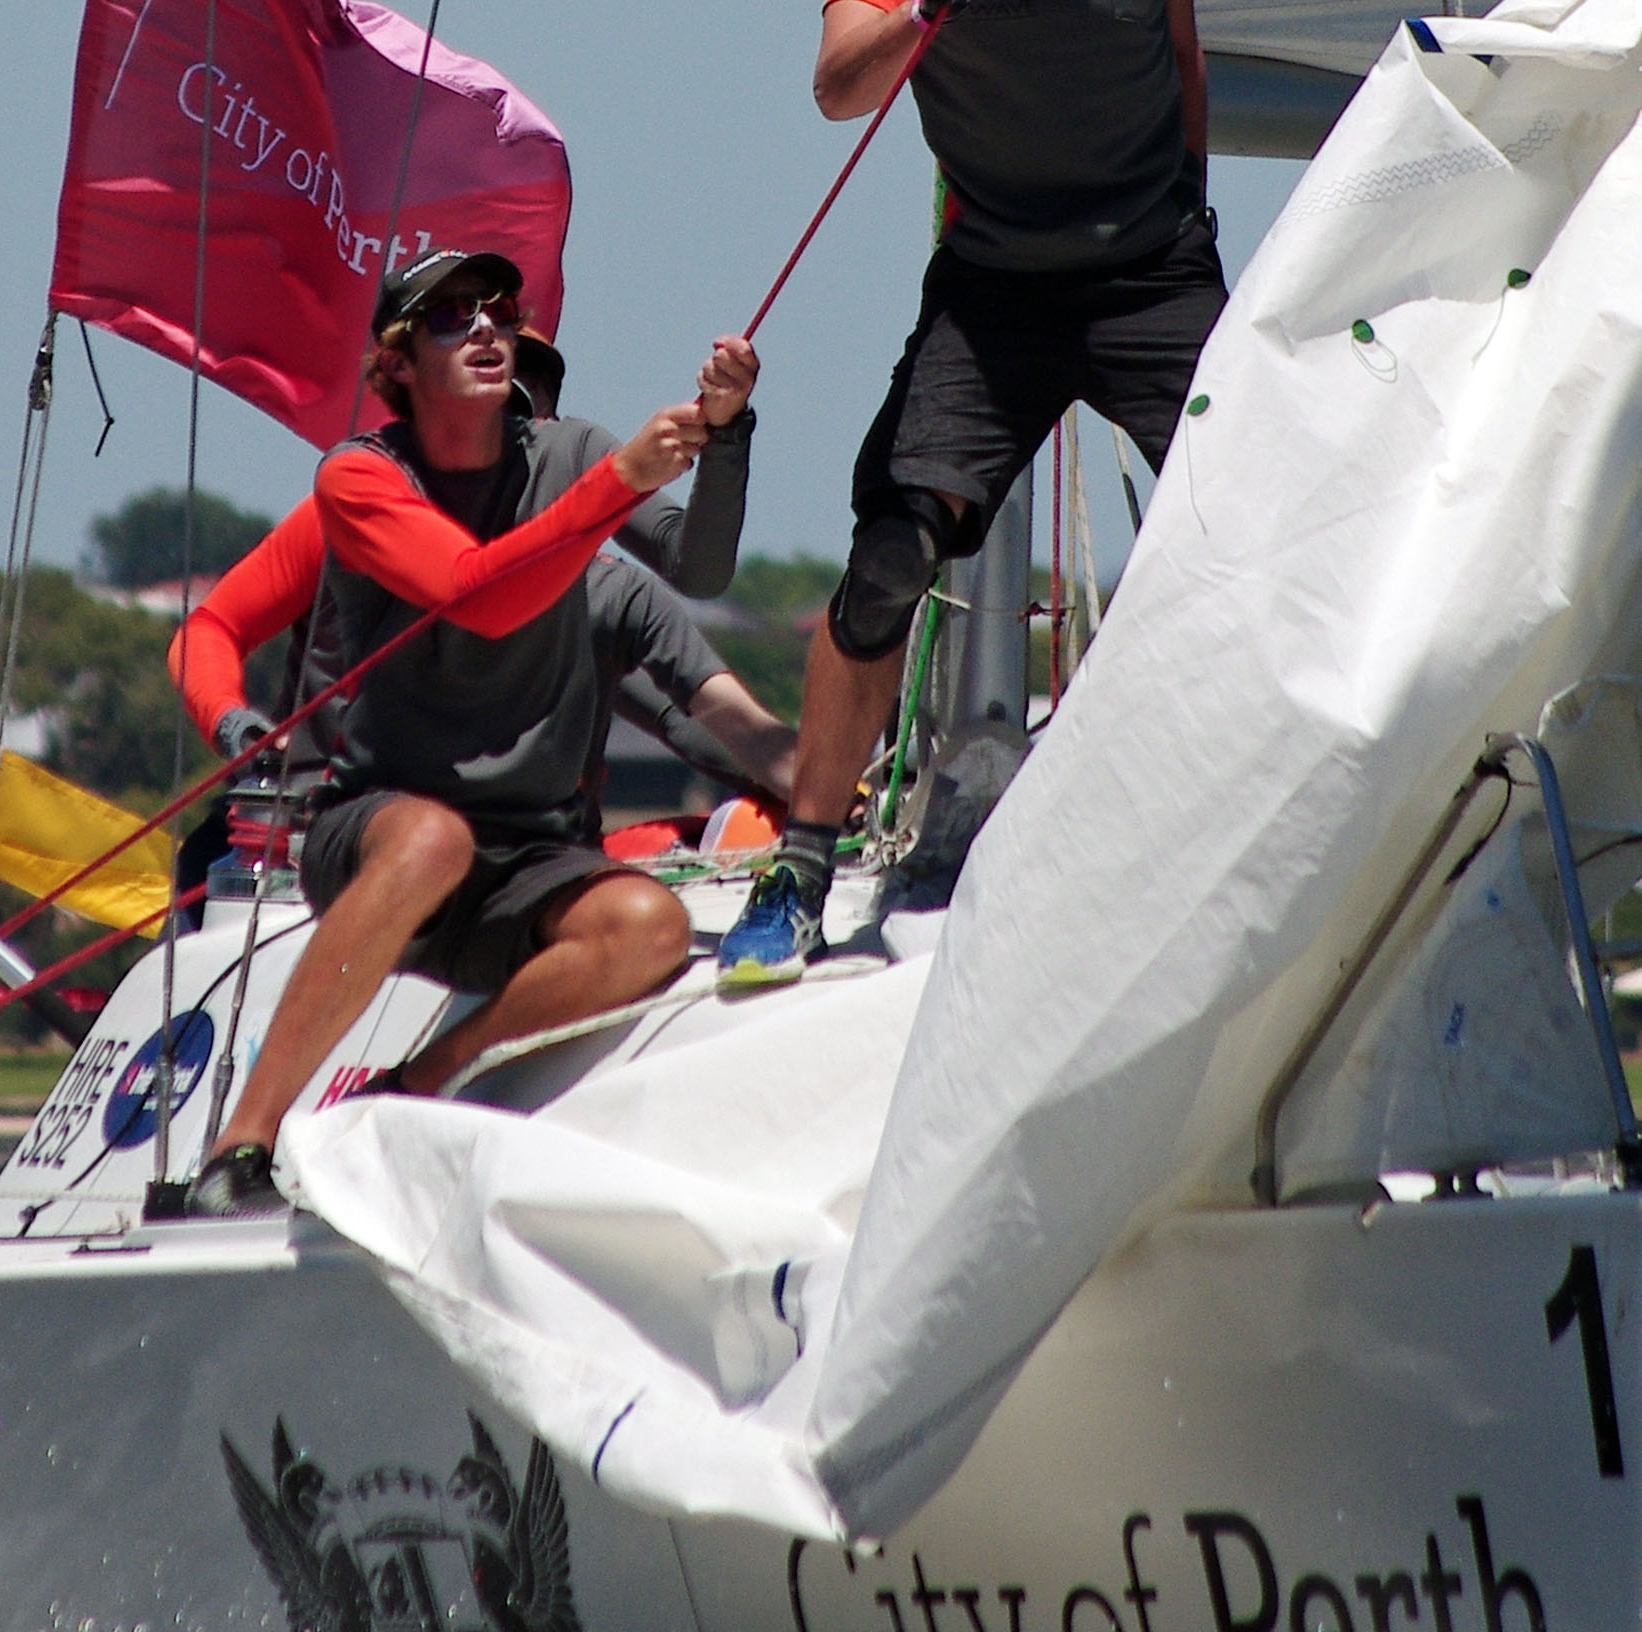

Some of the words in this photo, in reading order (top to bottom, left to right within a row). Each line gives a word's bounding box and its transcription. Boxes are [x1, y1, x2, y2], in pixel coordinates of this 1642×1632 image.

[177, 63, 286, 171] City
[286, 148, 328, 206] of
[323, 168, 432, 276] Pert
[17, 1103, 93, 1169] S252
[55, 1037, 130, 1104] HIRE
[1544, 1245, 1624, 1479] 1
